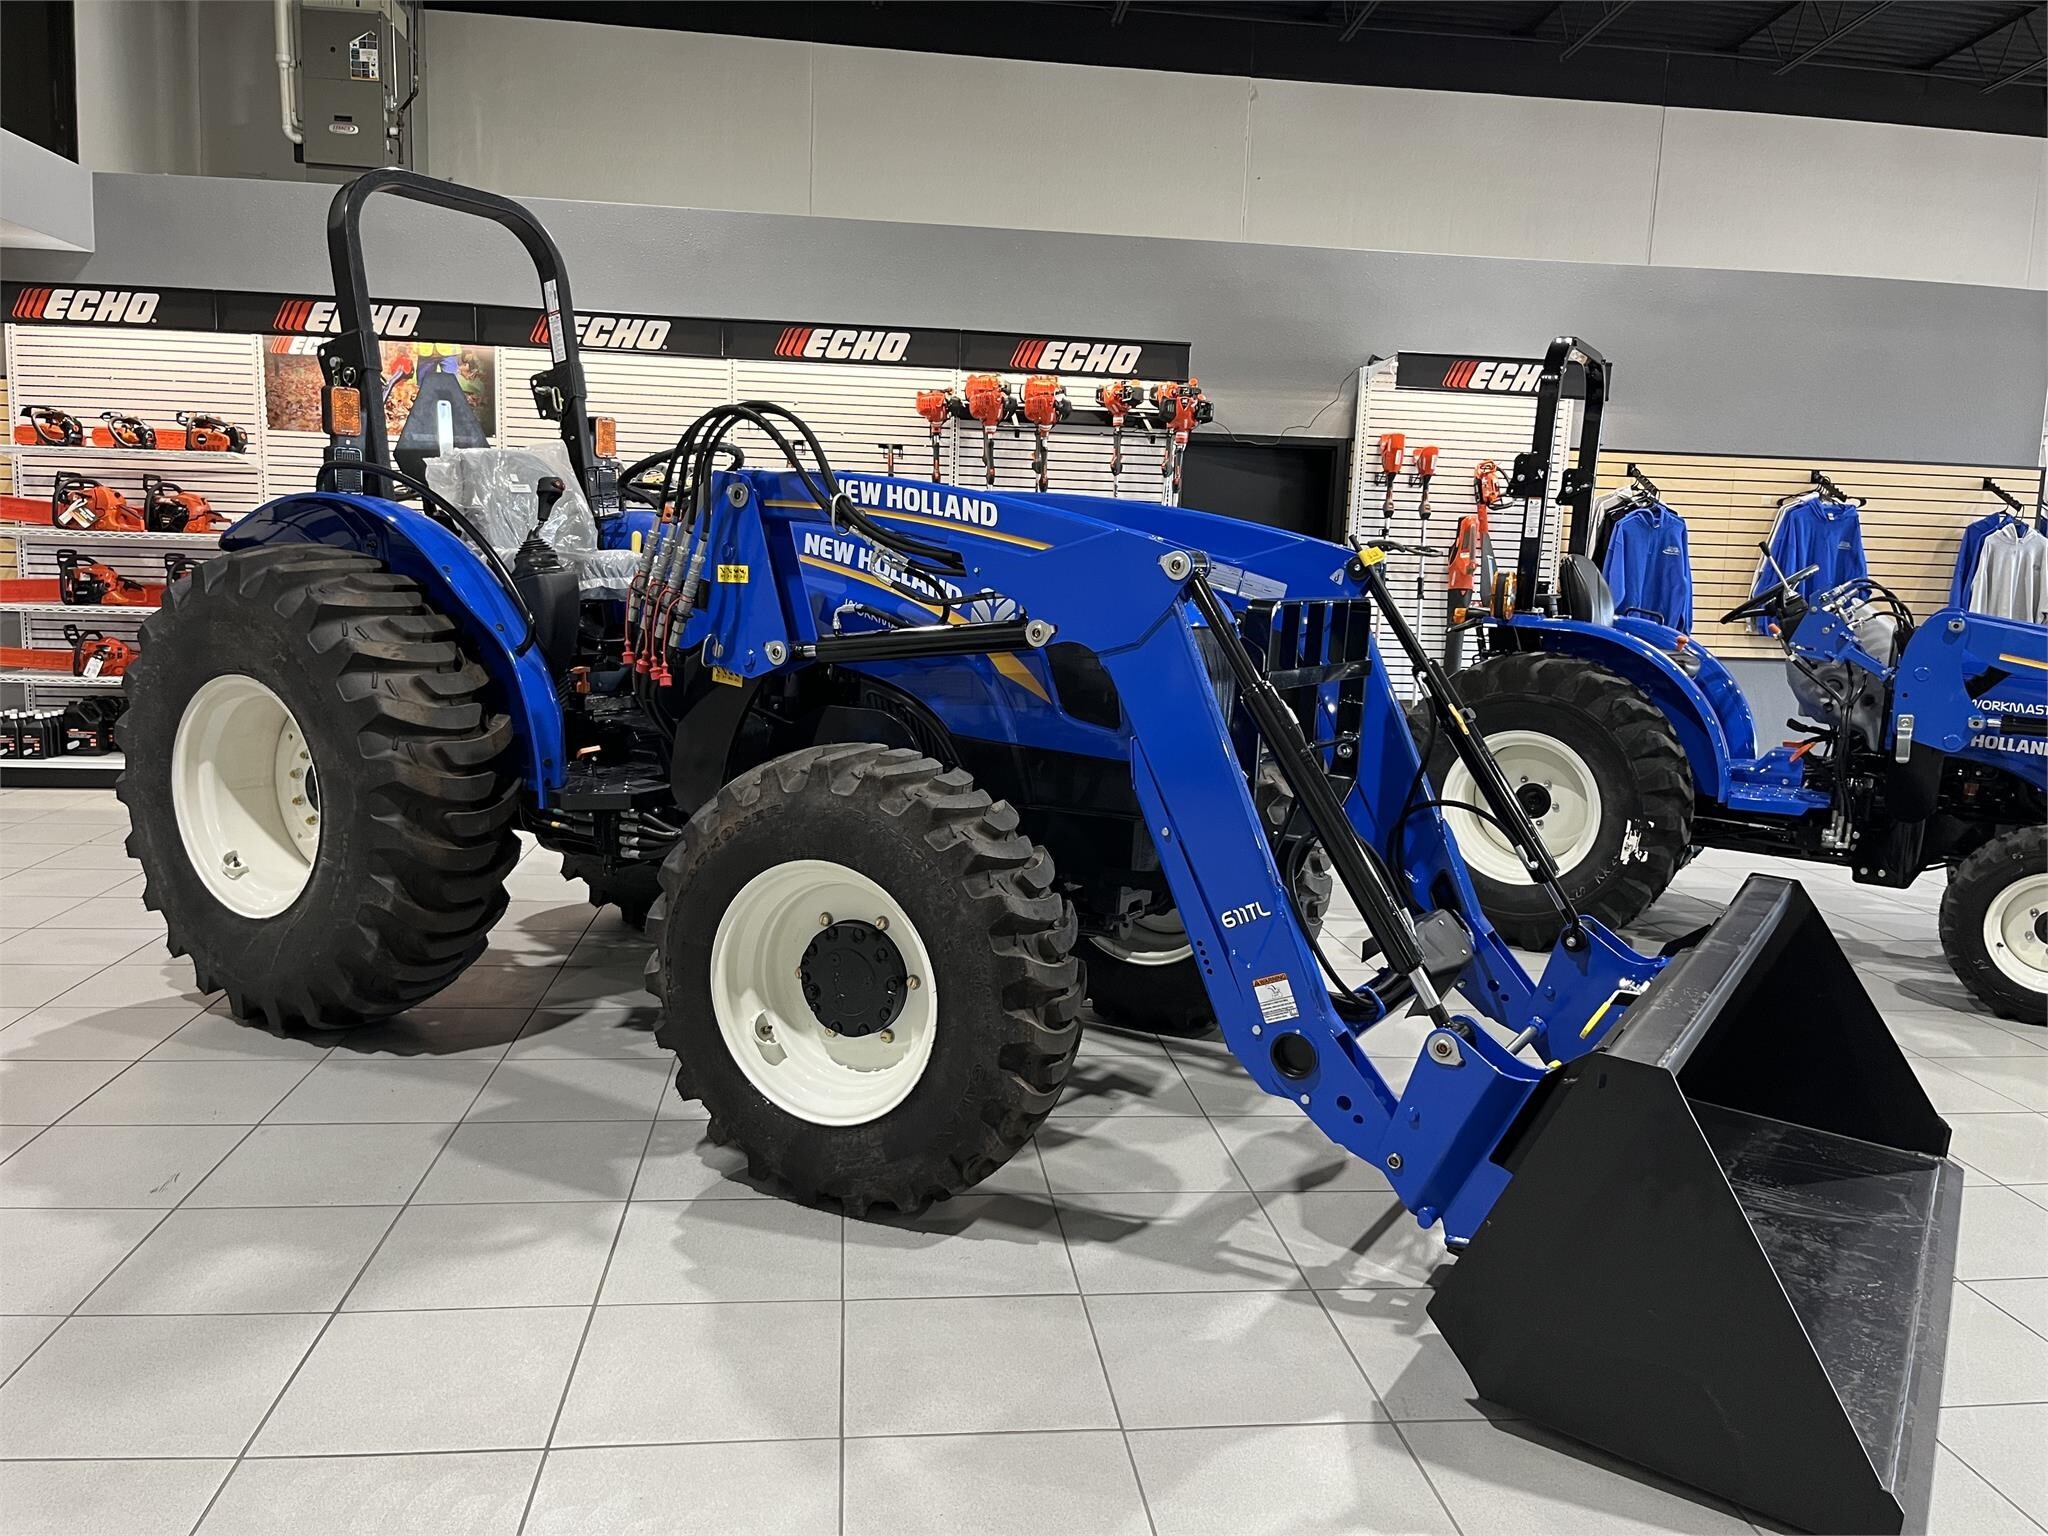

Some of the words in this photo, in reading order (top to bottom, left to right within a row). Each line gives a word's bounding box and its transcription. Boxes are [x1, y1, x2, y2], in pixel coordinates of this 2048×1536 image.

[43, 289, 160, 324] ECHO
[803, 328, 911, 361] ECHO
[1037, 341, 1142, 374] ECHO
[1468, 361, 1544, 392] ECH
[886, 484, 998, 527] HOLLAND
[804, 532, 855, 565] NEW
[1221, 901, 1271, 928] 611TL
